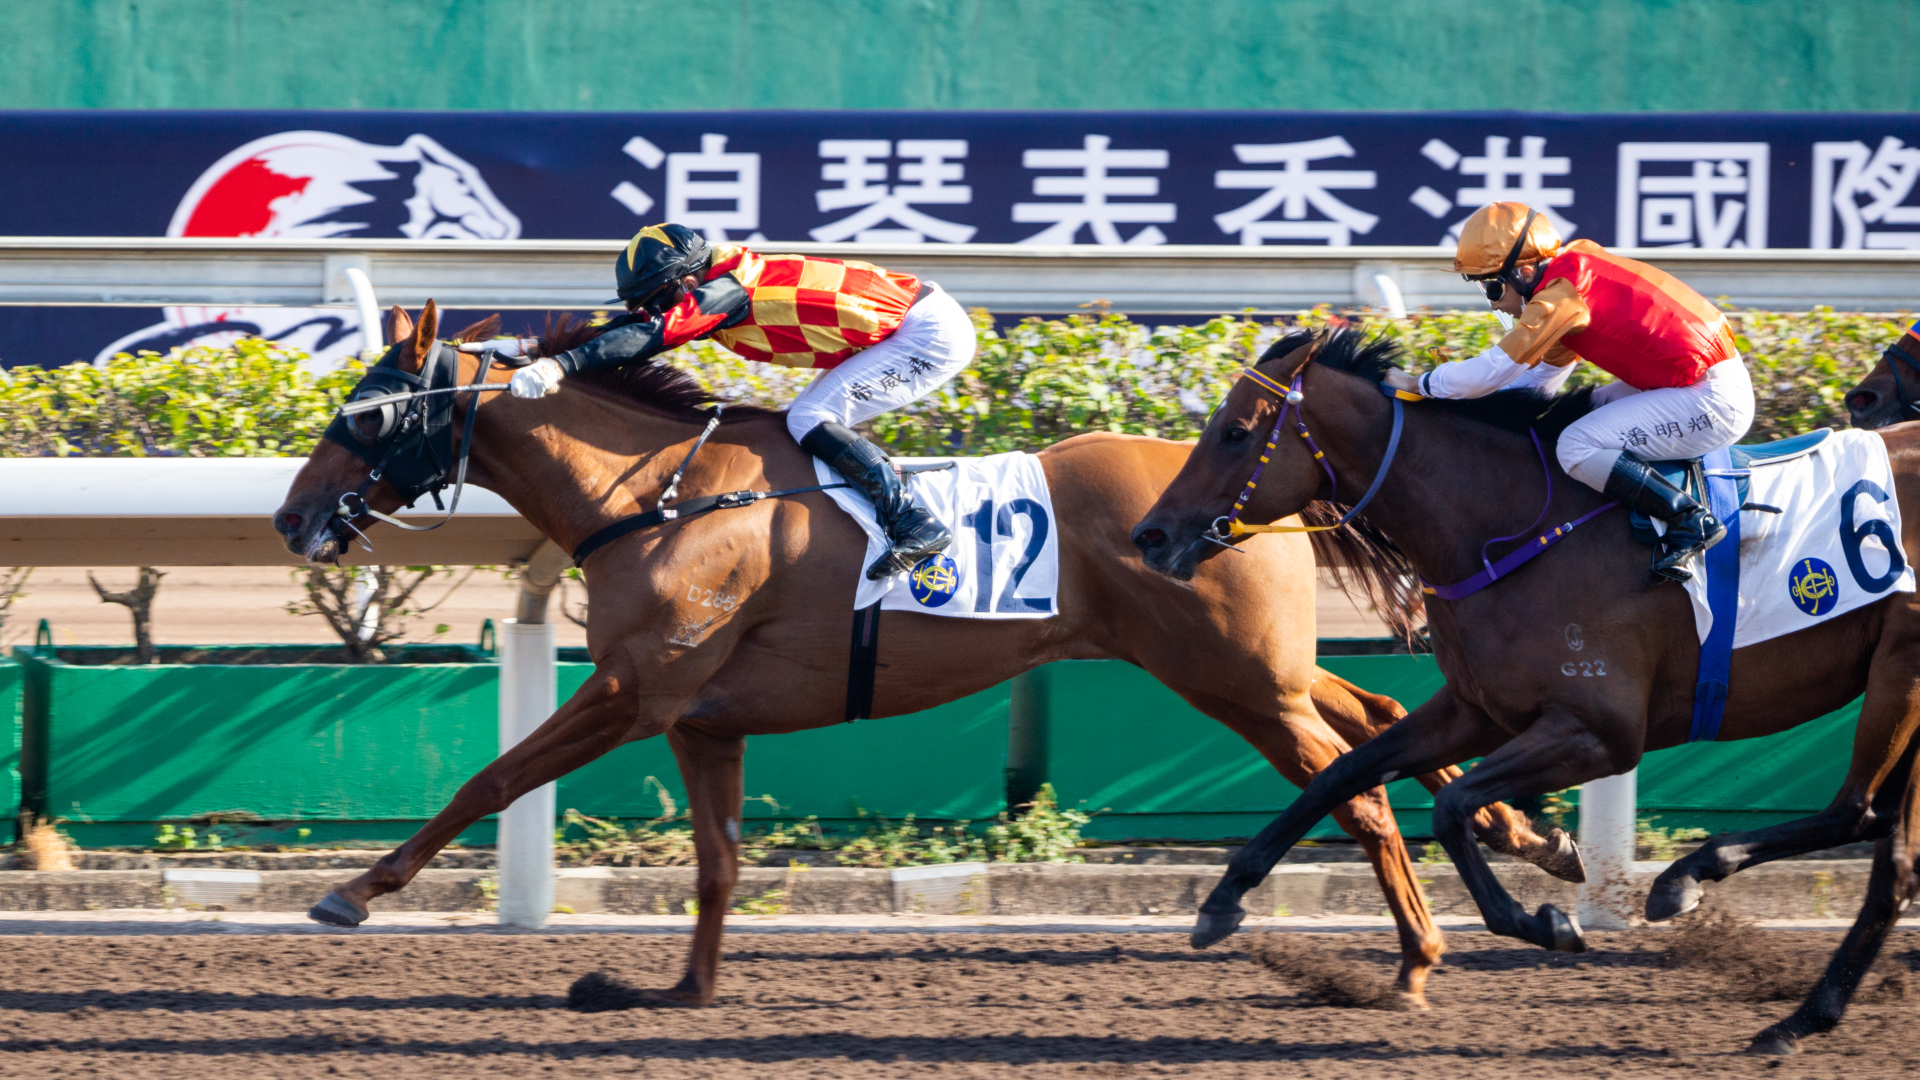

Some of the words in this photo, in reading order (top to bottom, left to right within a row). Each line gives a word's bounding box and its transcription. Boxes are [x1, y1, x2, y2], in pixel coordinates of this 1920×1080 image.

[1619, 411, 1718, 449] 潘明輝
[962, 498, 1050, 612] 12
[1839, 479, 1905, 594] 6
[1561, 660, 1607, 677] G22
